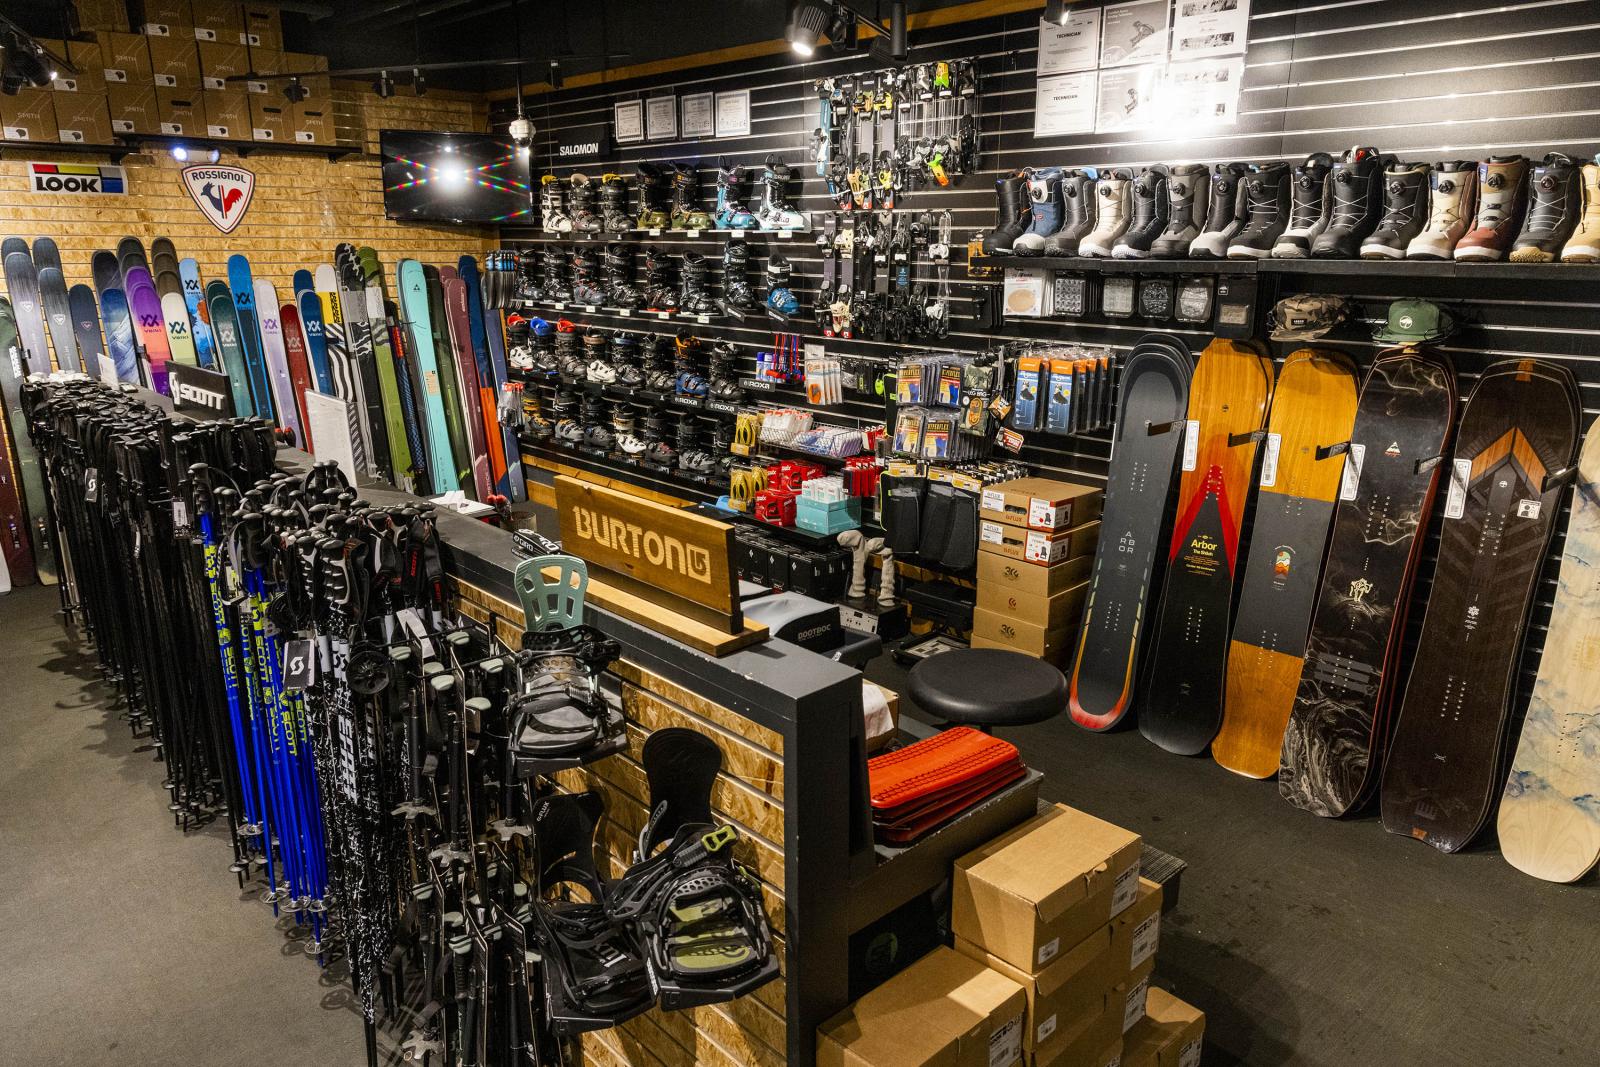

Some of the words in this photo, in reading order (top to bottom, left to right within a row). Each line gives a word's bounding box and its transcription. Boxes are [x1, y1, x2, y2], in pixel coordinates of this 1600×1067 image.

[1056, 31, 1082, 39] TECHNICIAN
[559, 142, 599, 157] SALOMON
[35, 176, 99, 193] LOOK
[192, 170, 247, 184] ROSSIGNOL
[180, 383, 225, 410] SCOTT
[572, 505, 687, 576] BURTON
[1190, 538, 1218, 551] Arbor
[255, 635, 269, 683] SCOTT
[295, 699, 308, 744] SCOTT
[282, 709, 298, 757] SCOTT
